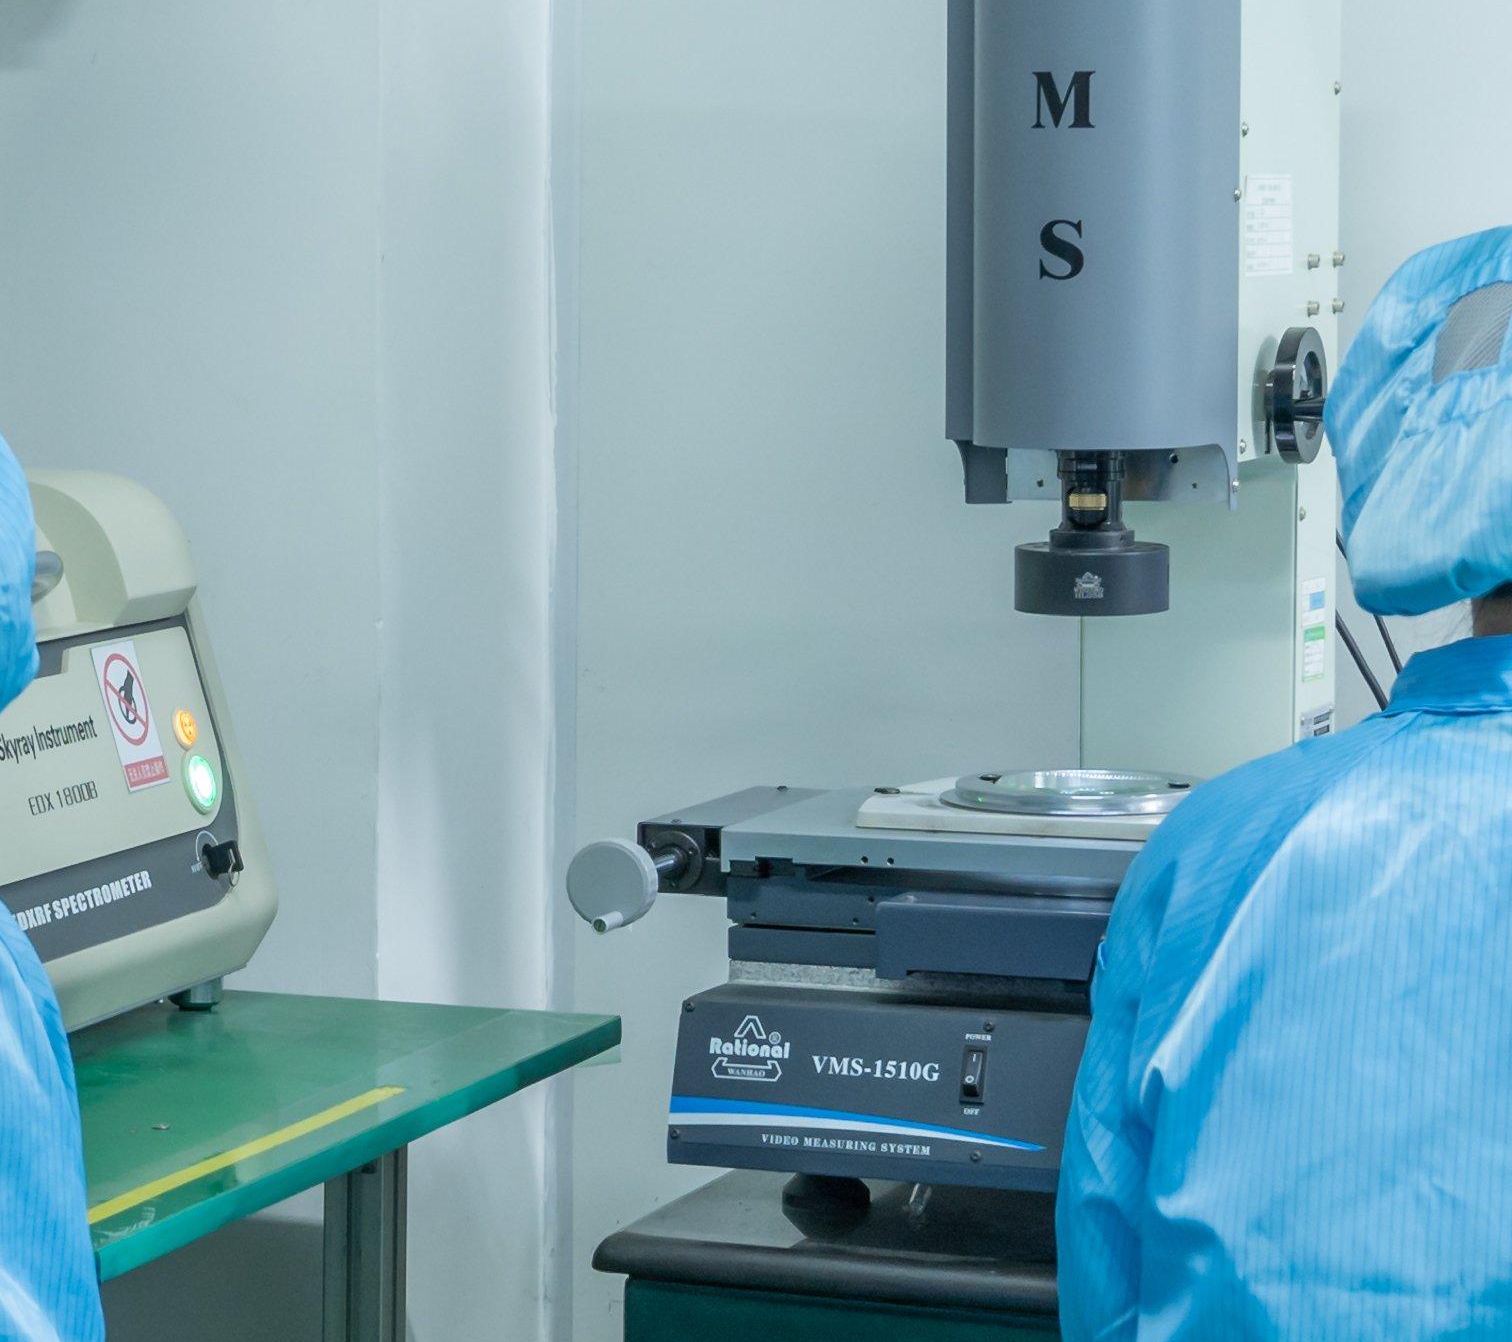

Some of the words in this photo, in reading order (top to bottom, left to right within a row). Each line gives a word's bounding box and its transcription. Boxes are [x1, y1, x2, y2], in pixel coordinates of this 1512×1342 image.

[33, 715, 98, 752] Instrument
[28, 791, 55, 816] EDX
[56, 780, 99, 809] 1800B
[13, 902, 53, 931] DXRF
[51, 870, 153, 921] SPECTROMETER
[709, 1036, 791, 1059] Rational
[727, 1067, 767, 1078] WANHAO
[812, 1053, 941, 1083] VMS-1510G
[761, 1132, 800, 1147] VIDEO
[802, 1135, 877, 1153] MEASURING
[880, 1140, 932, 1157] SYSTEM
